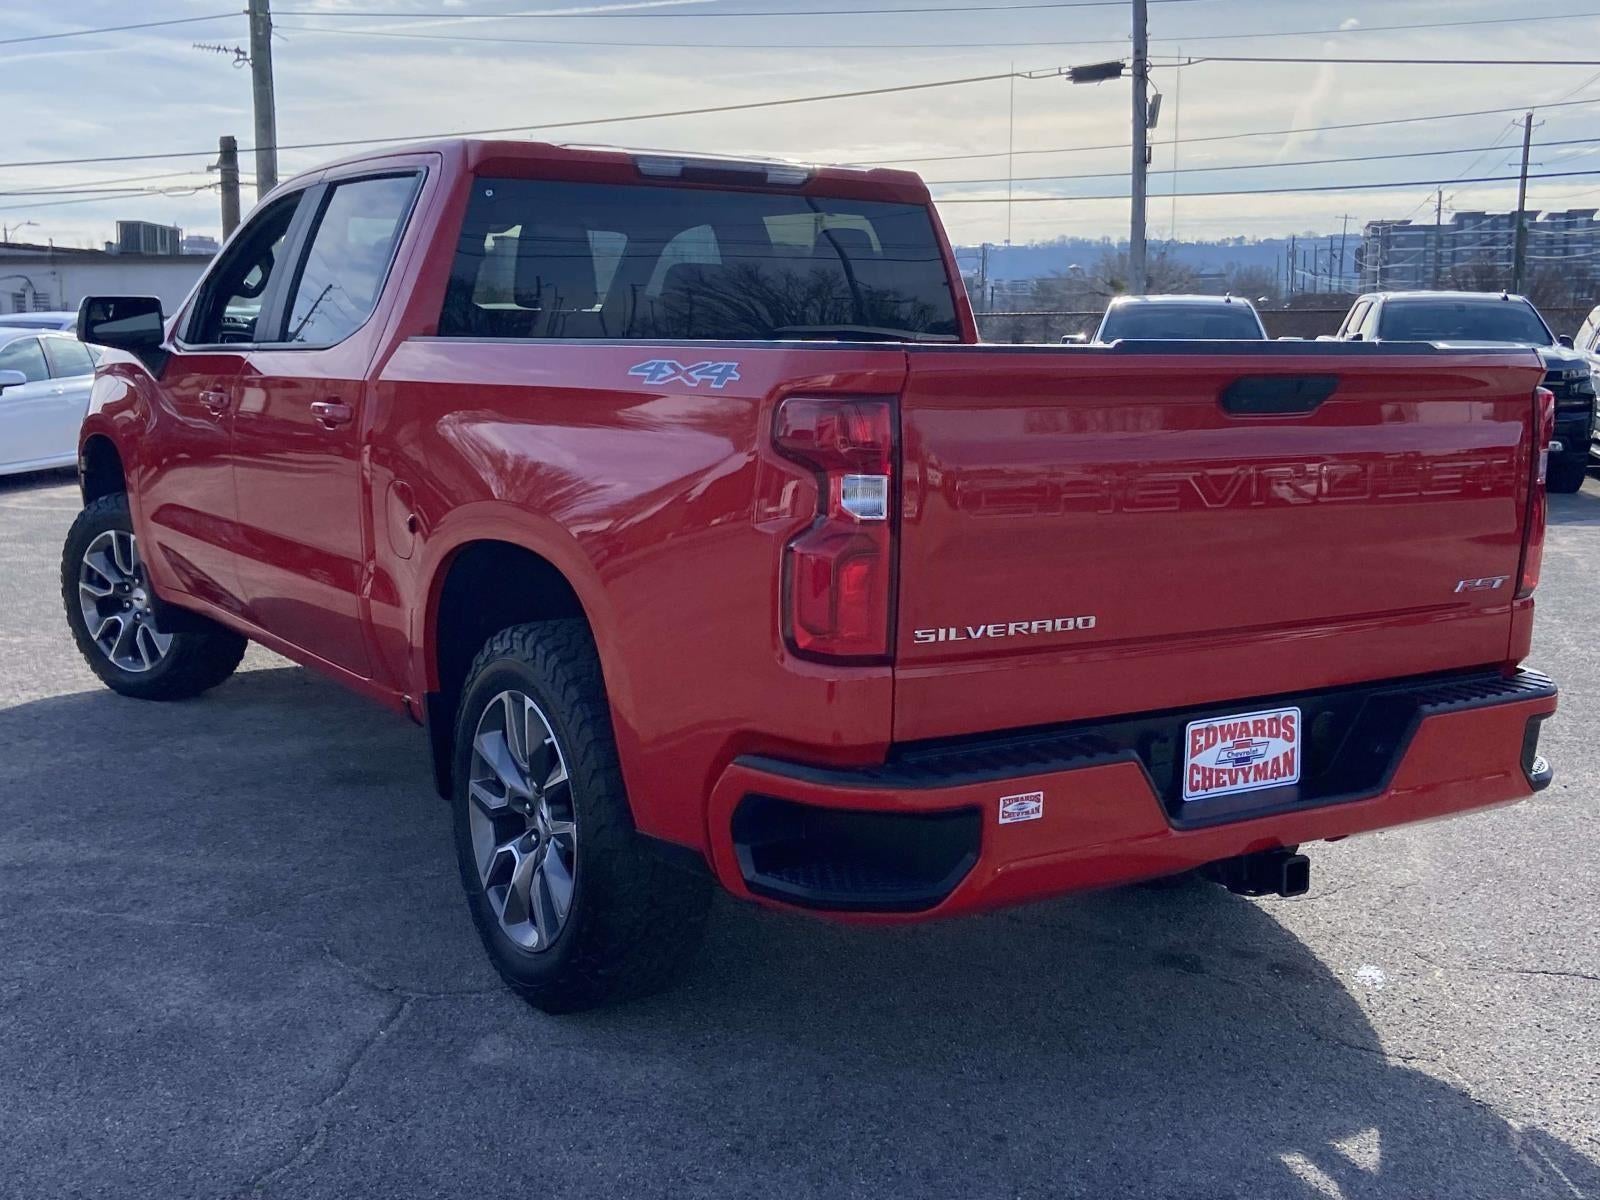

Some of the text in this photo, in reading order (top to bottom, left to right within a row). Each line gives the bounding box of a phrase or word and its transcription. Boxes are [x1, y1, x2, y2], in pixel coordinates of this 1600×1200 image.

[628, 359, 741, 388] 4X4
[914, 615, 1096, 644] SILVERADO
[1190, 715, 1295, 759] EDWARDS
[1226, 748, 1258, 758] Chevrolet
[1189, 748, 1295, 793] CHEVYMAN
